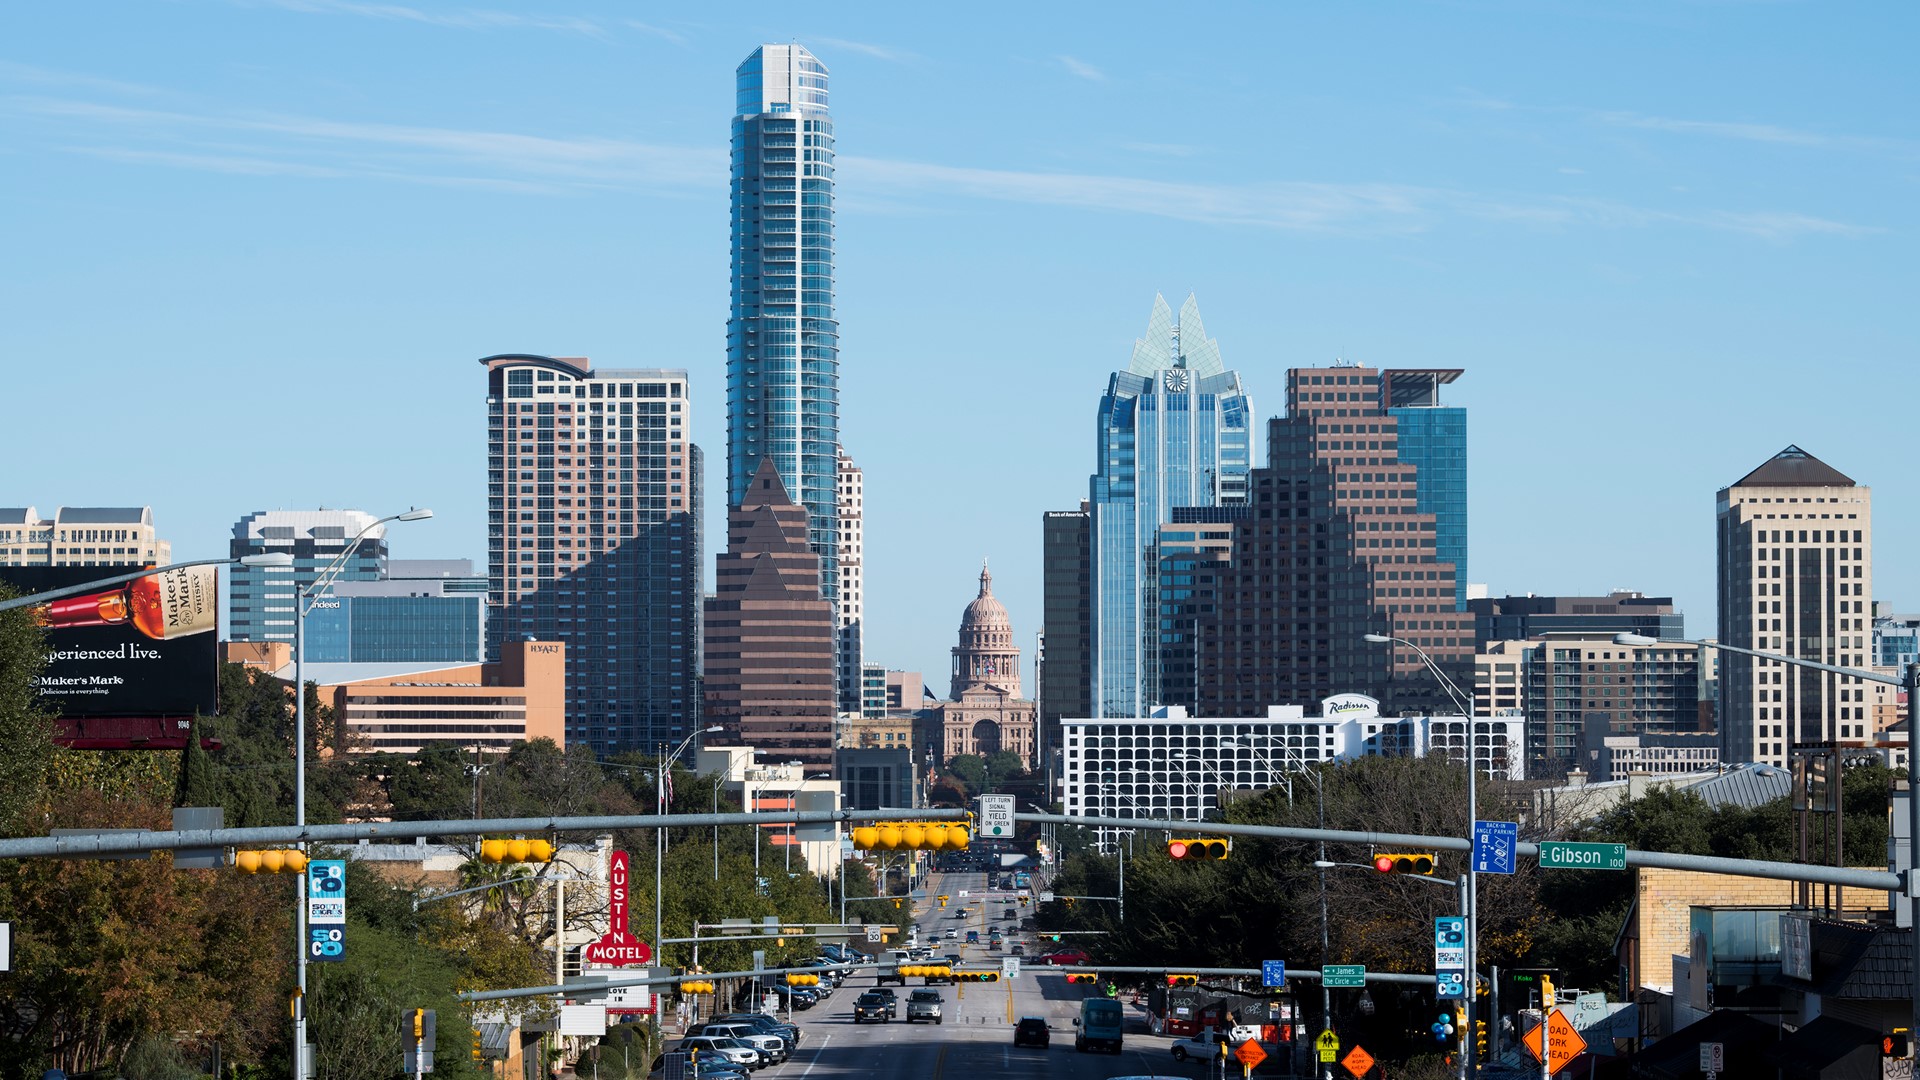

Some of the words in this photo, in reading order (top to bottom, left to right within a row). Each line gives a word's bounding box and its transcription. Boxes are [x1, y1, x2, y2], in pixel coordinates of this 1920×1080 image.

[177, 567, 190, 609] Mark
[193, 573, 202, 615] WHISKY
[41, 643, 125, 663] perienced
[129, 643, 162, 659] live.
[531, 645, 559, 653] HYATT
[40, 676, 88, 686] Maker's
[40, 687, 69, 696] Delicious
[1329, 701, 1369, 714] Radisson
[1541, 849, 1547, 859] E
[1551, 846, 1601, 864] Gibson
[1613, 846, 1624, 855] ST
[1609, 858, 1624, 868] 100
[613, 857, 625, 944] AUSTIN
[592, 947, 643, 959] MOTEL
[1336, 967, 1355, 975] James
[1324, 977, 1333, 985] The
[1334, 977, 1350, 985] Circle
[1549, 1025, 1568, 1036] OAD
[1549, 1038, 1567, 1047] ORK
